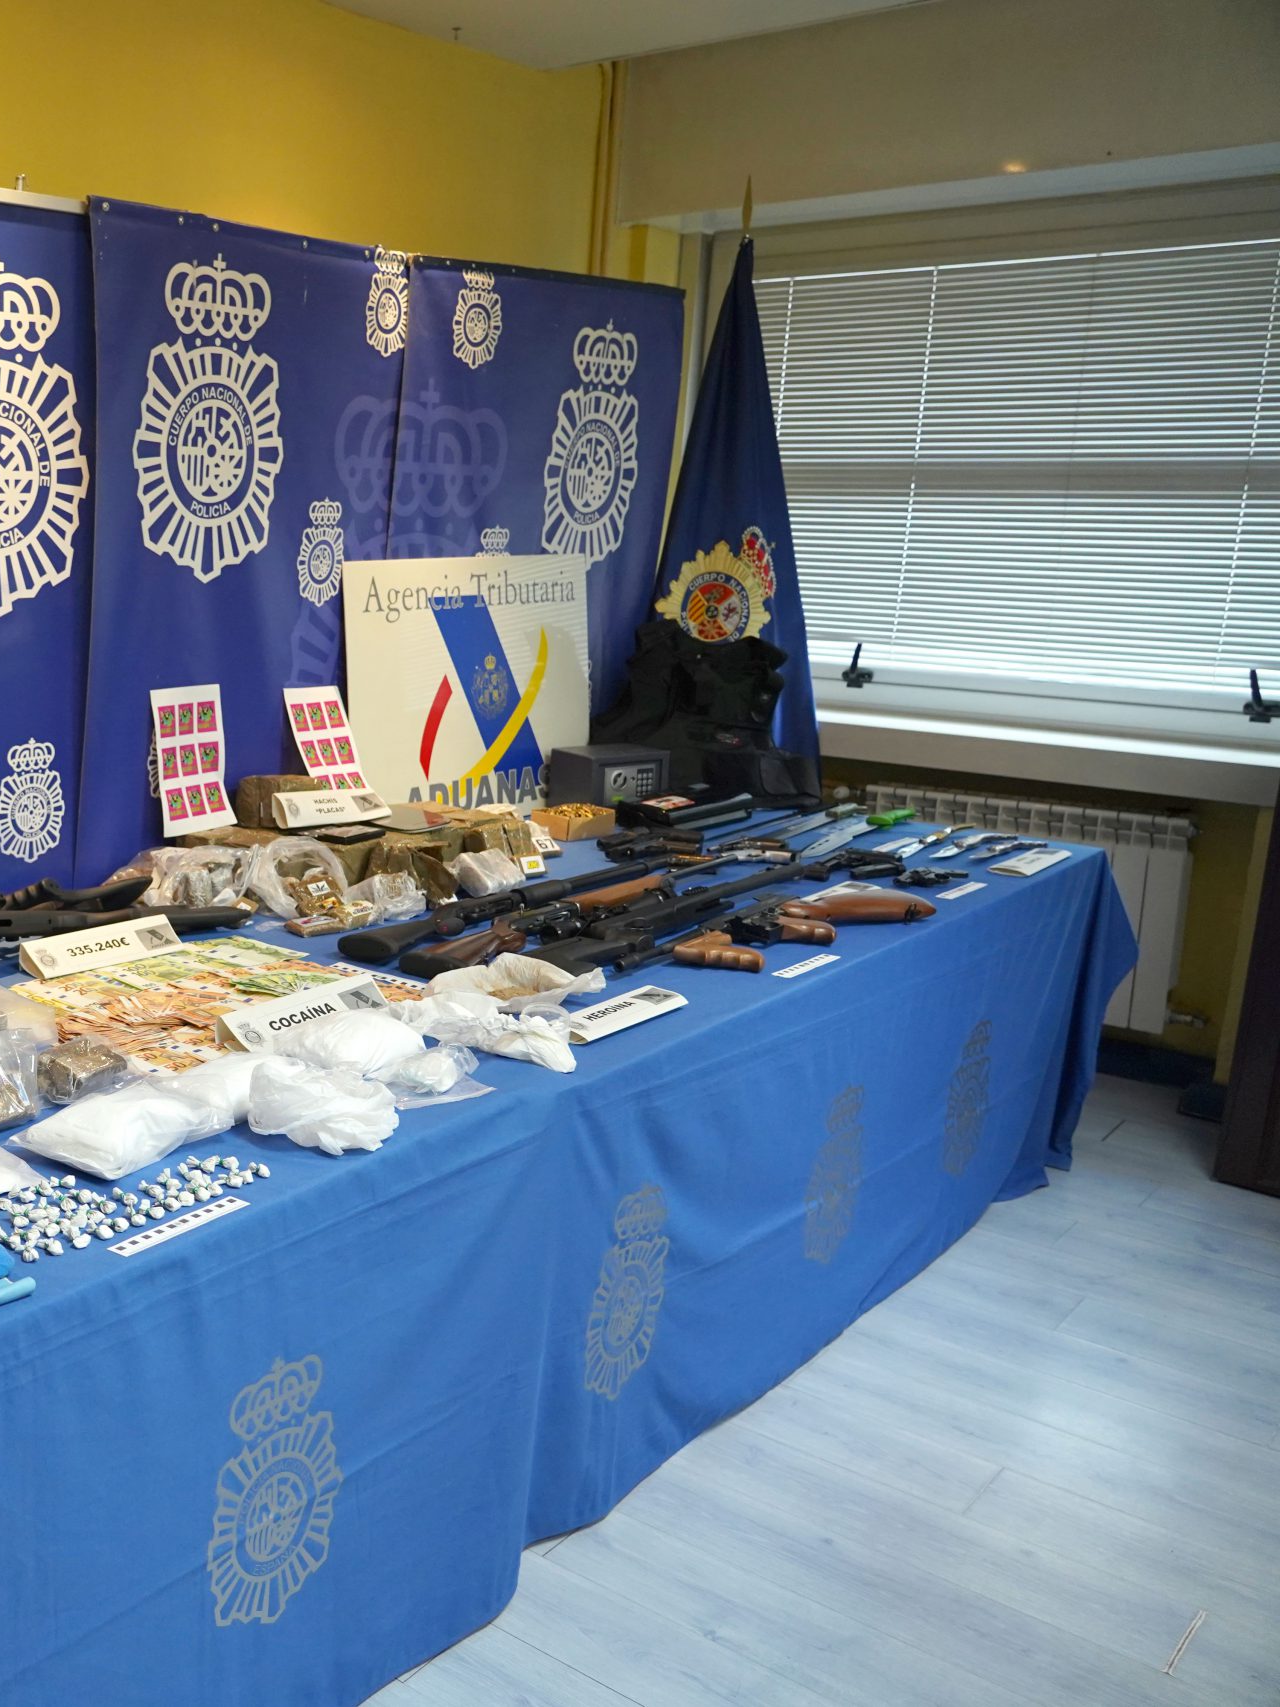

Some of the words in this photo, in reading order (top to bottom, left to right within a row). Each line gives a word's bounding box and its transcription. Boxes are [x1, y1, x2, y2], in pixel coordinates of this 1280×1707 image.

[168, 391, 200, 446] CUERPO
[201, 386, 246, 424] NACIONAL
[243, 425, 253, 446] DE
[585, 422, 616, 451] NACIONAL
[39, 460, 51, 488] DE
[190, 501, 232, 518] POLICIA
[573, 511, 600, 524] POLICIA
[362, 574, 464, 624] Agencia
[470, 570, 576, 608] Tributaria
[689, 573, 726, 591] CUERPO
[728, 578, 750, 628] NACIONAL
[408, 763, 552, 810] ADUANAS
[536, 838, 555, 849] 67
[66, 936, 131, 957] 335.240€
[268, 1002, 337, 1031] COCAÍNA
[583, 1001, 636, 1022] HEROÍNA
[163, 1061, 187, 1072] 50
